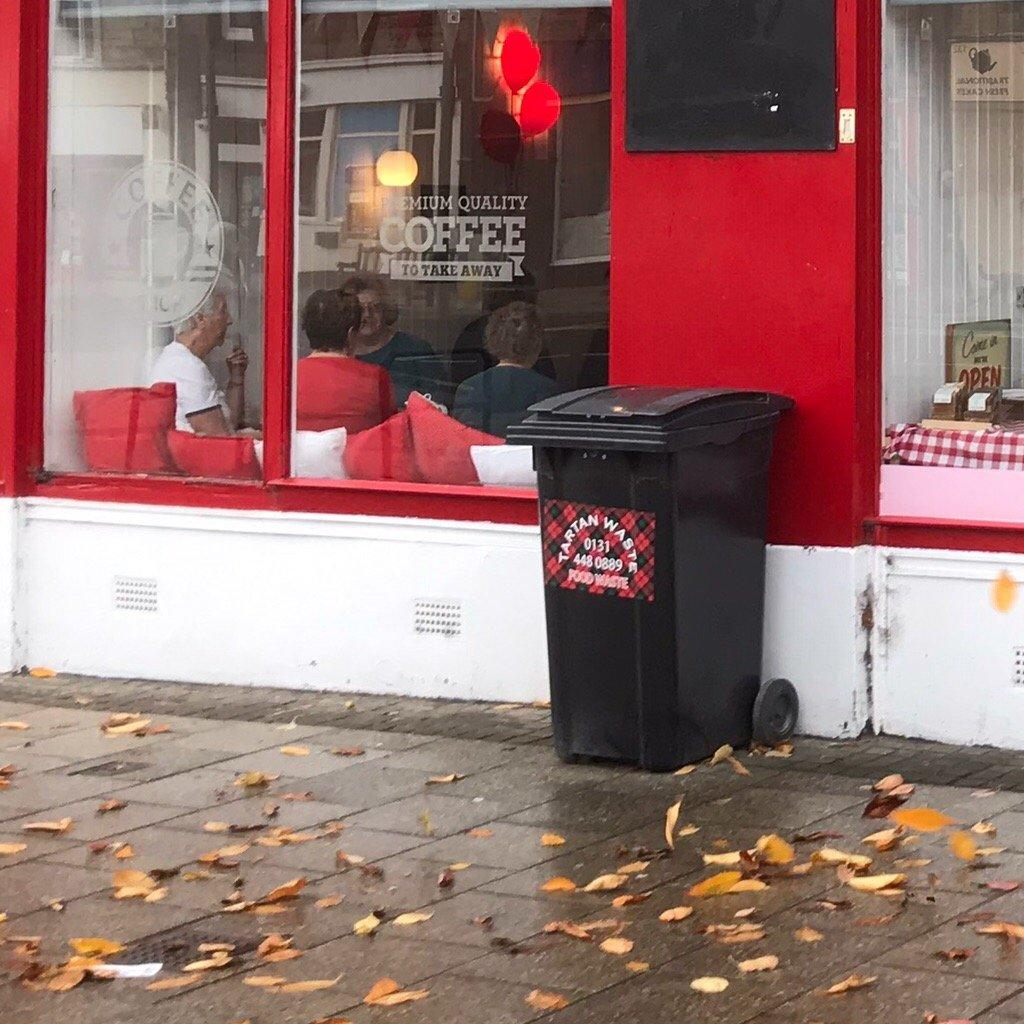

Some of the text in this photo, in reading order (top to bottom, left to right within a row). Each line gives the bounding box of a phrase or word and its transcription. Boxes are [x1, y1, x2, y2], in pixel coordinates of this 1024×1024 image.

[382, 195, 528, 212] EMIUM QUALITY
[379, 216, 526, 253] COFFEE
[401, 264, 503, 278] TO TAKE AWAY
[958, 364, 1001, 391] OPEN
[558, 514, 638, 574] TARTAN WASTE
[584, 537, 610, 553] 0131
[573, 553, 623, 572] 448 0889
[568, 568, 594, 585] FOOD
